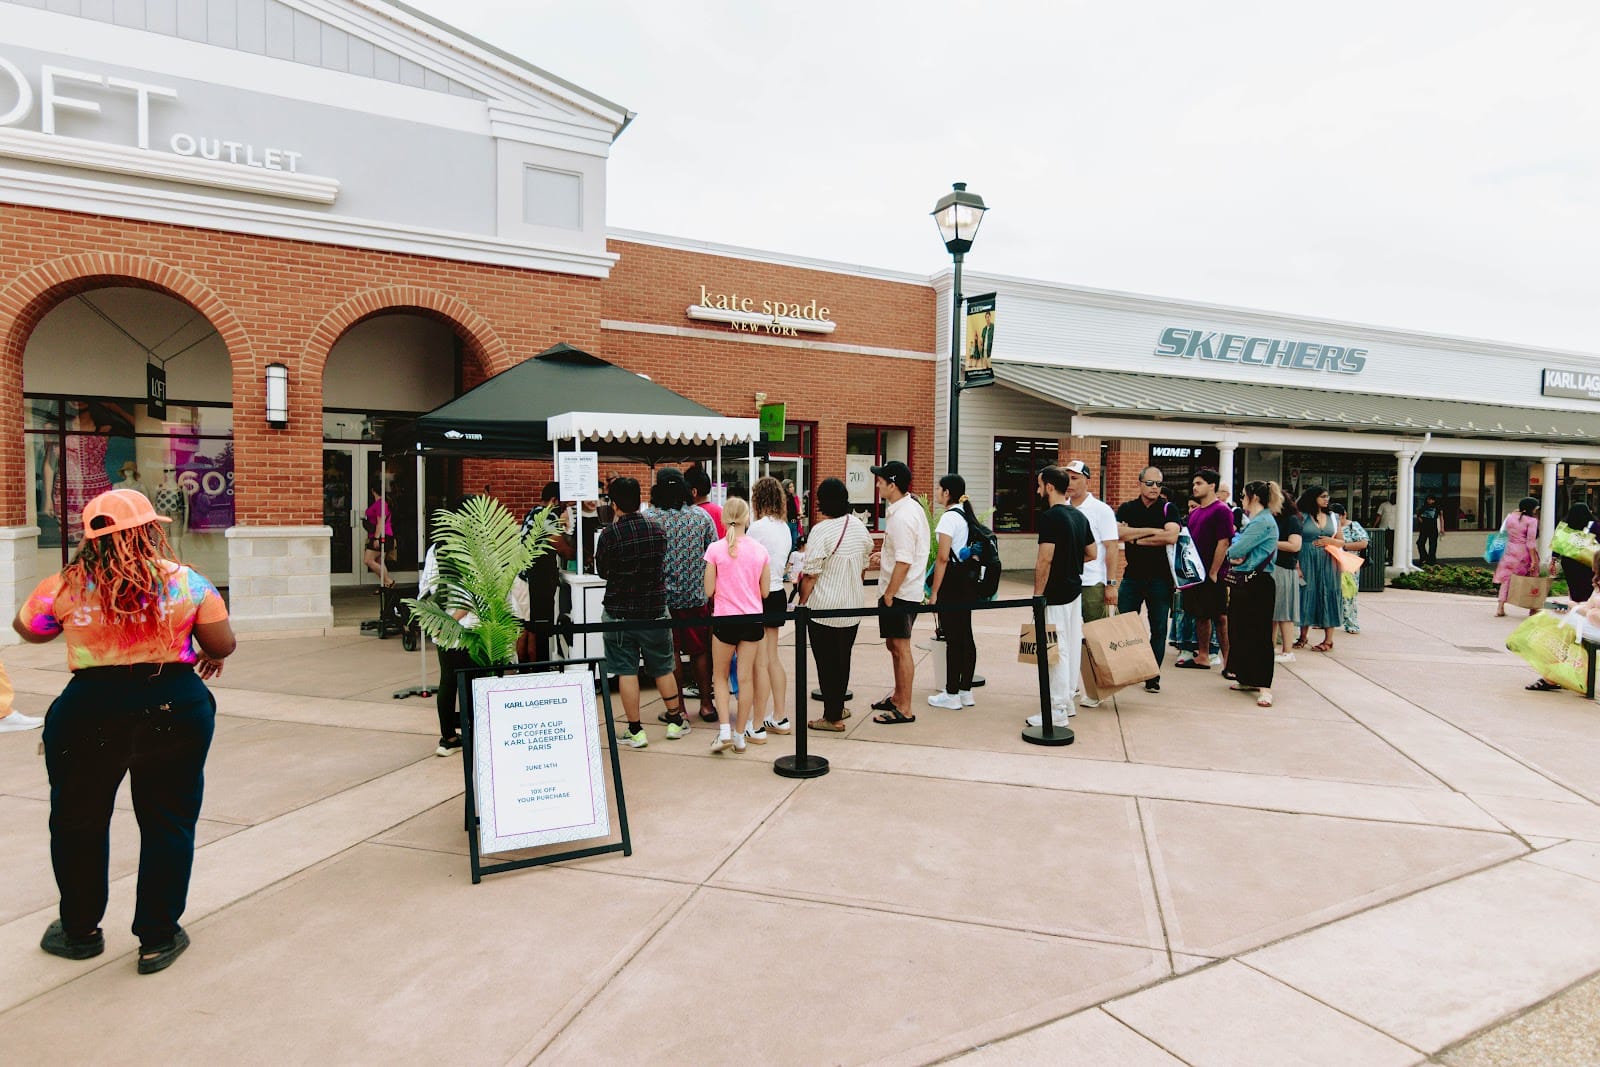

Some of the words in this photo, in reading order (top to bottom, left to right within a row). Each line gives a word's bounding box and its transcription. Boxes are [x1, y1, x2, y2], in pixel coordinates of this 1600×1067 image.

[170, 133, 302, 172] OUTLET
[699, 285, 753, 313] kate
[762, 299, 830, 324] spade
[731, 320, 759, 333] NEW
[765, 323, 799, 337] YORK
[1155, 327, 1369, 375] SKECHERS
[1545, 370, 1577, 389] KARL
[1020, 641, 1037, 655] NIKE
[504, 701, 524, 709] KARL
[525, 698, 568, 707] LAGERFELD
[511, 731, 522, 739] OF
[524, 729, 552, 737] COFFEE
[554, 727, 566, 735] ON
[512, 723, 538, 731] ENJOY
[504, 739, 526, 747] KARL
[528, 734, 574, 744] LAGERFELD
[528, 743, 552, 751] PARIS
[525, 763, 542, 771] JUNE
[517, 796, 535, 804] YOUR
[536, 792, 570, 801] PURCHASE
